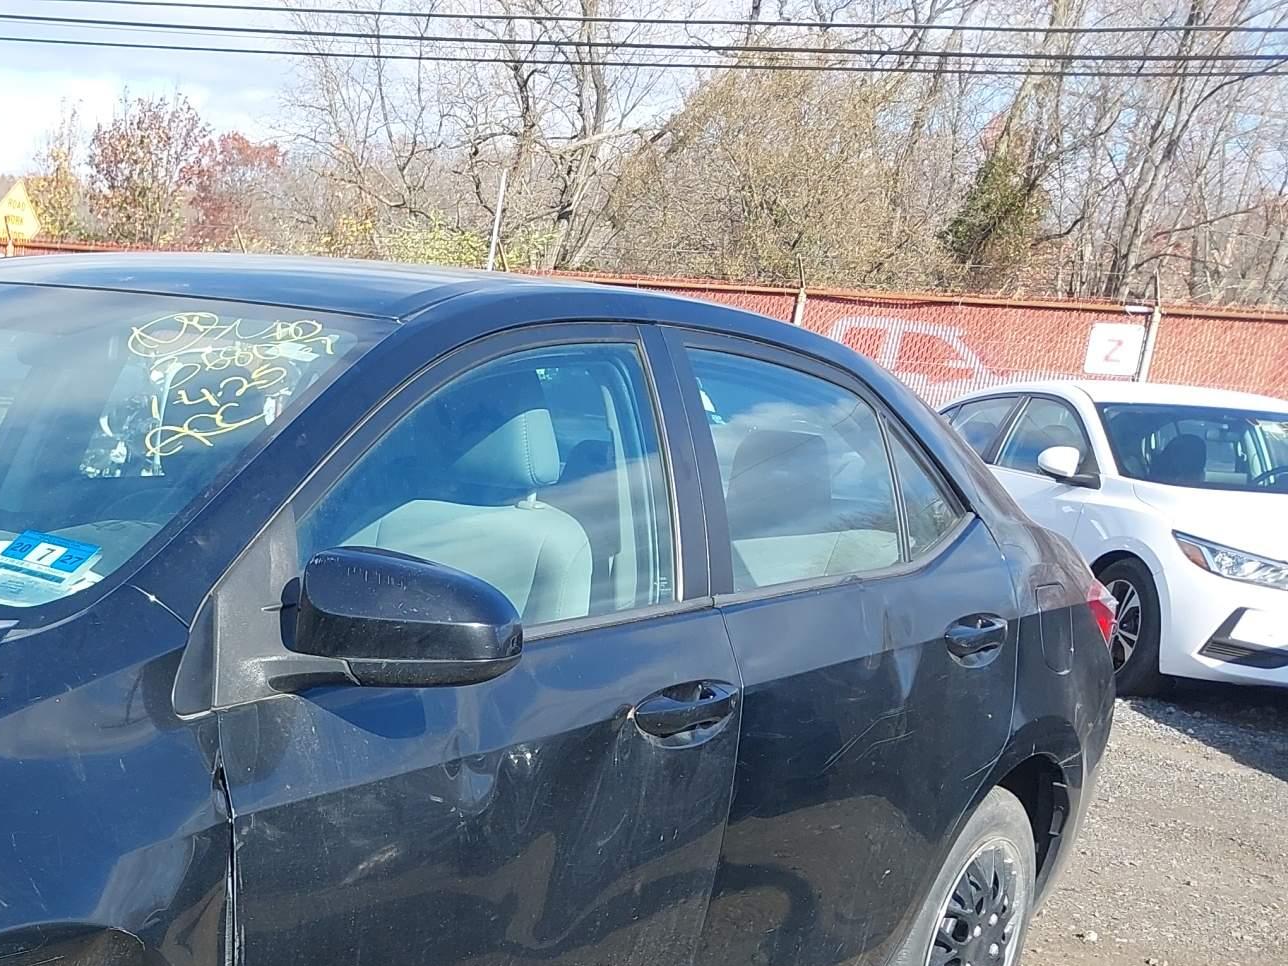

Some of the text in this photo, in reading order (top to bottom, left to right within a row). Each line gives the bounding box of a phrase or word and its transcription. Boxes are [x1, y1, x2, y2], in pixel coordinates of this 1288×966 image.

[12, 542, 32, 553] 20
[36, 547, 57, 562] 7
[59, 554, 83, 566] 27
